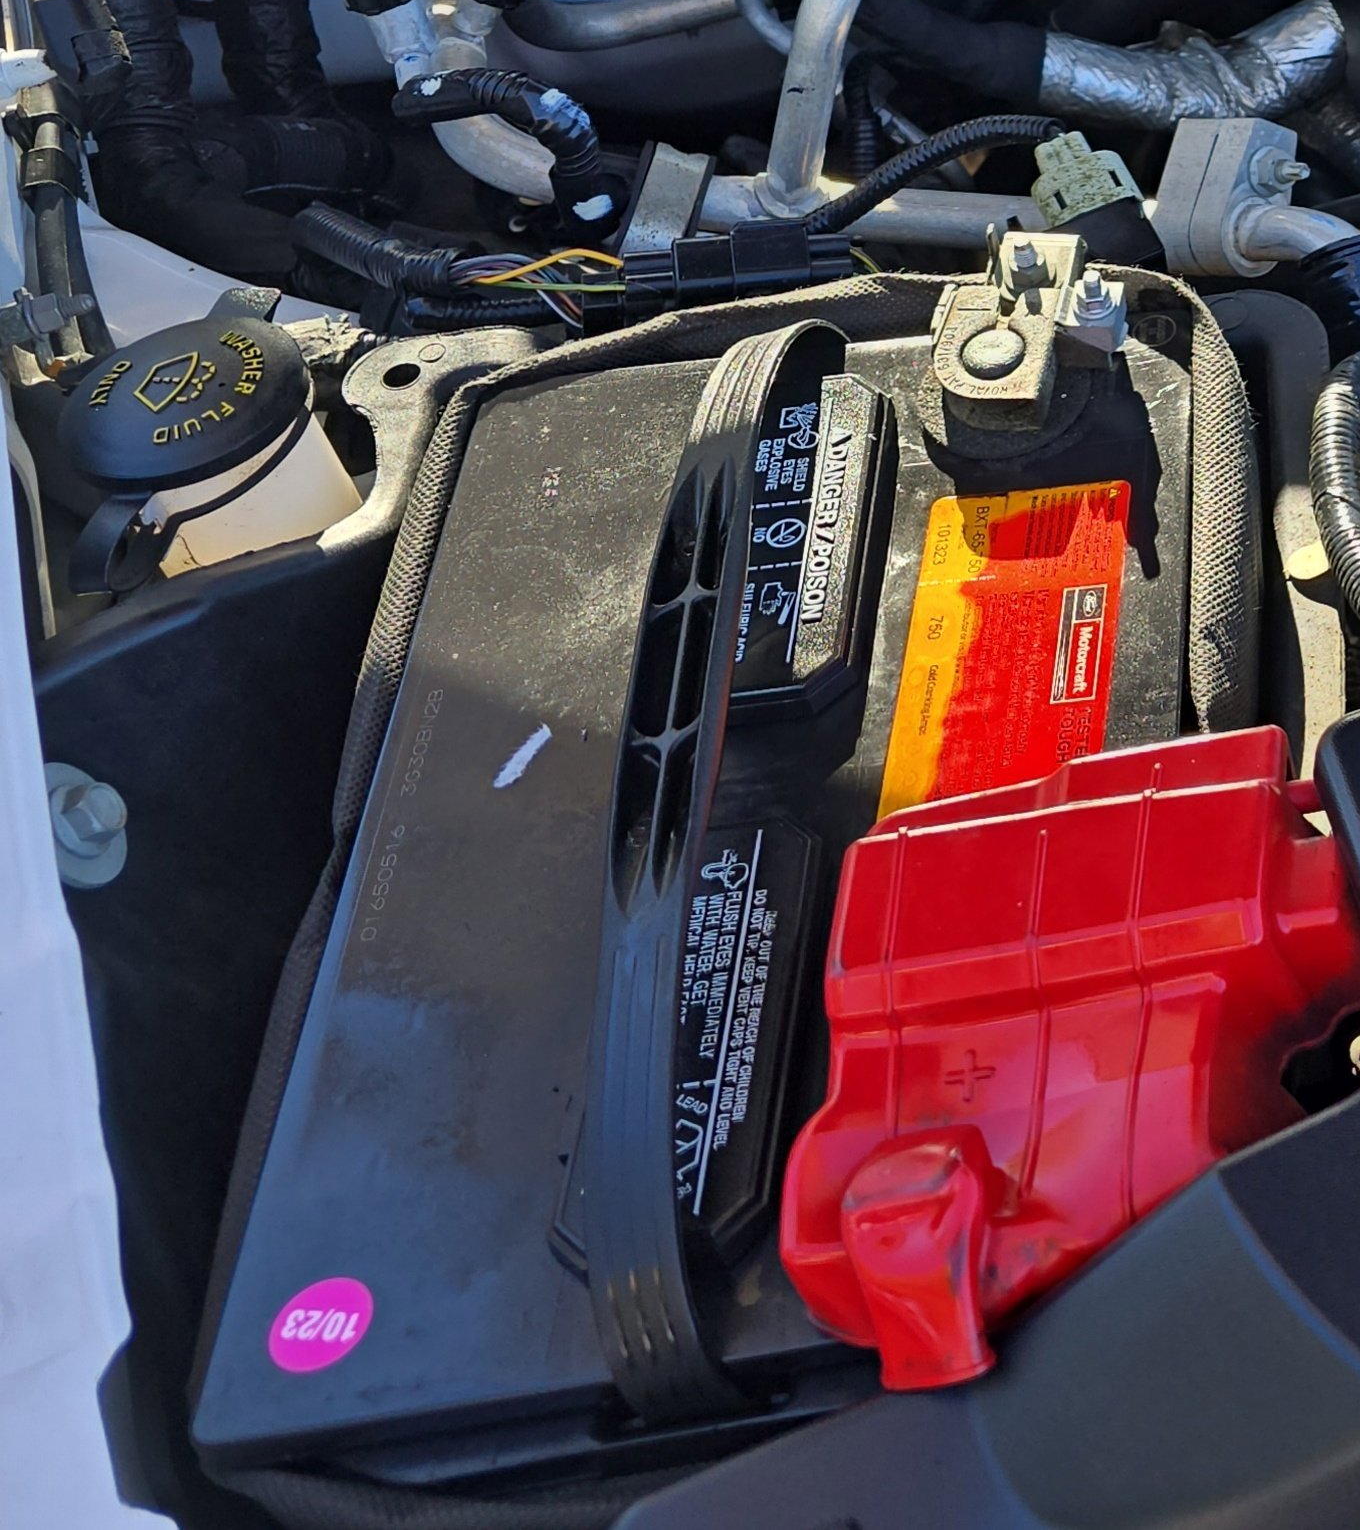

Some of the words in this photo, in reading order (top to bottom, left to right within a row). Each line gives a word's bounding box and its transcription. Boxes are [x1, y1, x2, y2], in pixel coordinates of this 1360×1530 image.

[220, 330, 265, 395] WASHER
[89, 360, 132, 405] ONLY
[153, 400, 235, 445] FLUID
[755, 439, 771, 472] GASES
[764, 438, 783, 491] EXPLOSIVE
[779, 461, 794, 484] EYES
[792, 457, 808, 491] SHIELD
[753, 526, 765, 543] NO
[931, 524, 951, 565] 101323
[967, 505, 989, 572] BXT-65-750
[926, 615, 943, 639] 750
[927, 664, 938, 680] Cold
[1072, 626, 1093, 693] Motorcraft
[1074, 708, 1092, 755] TESTE
[359, 823, 407, 943] 01650516
[752, 888, 766, 905] DO
[703, 892, 724, 925] WITH
[720, 889, 742, 930] FLUSH
[748, 908, 763, 931] NOT
[714, 934, 734, 968] EYES
[757, 940, 772, 961] OUT
[754, 965, 768, 981] OF
[689, 980, 708, 1006] GET
[735, 986, 751, 1014] VENT
[698, 971, 727, 1058] IMMEDIATELY
[730, 1018, 746, 1047] CAPS
[724, 1050, 741, 1081] TIGHT
[676, 1094, 708, 1115] LEAD
[720, 1087, 735, 1109] AND
[713, 1113, 731, 1149] LEVEL
[280, 1311, 361, 1344] 10/23
